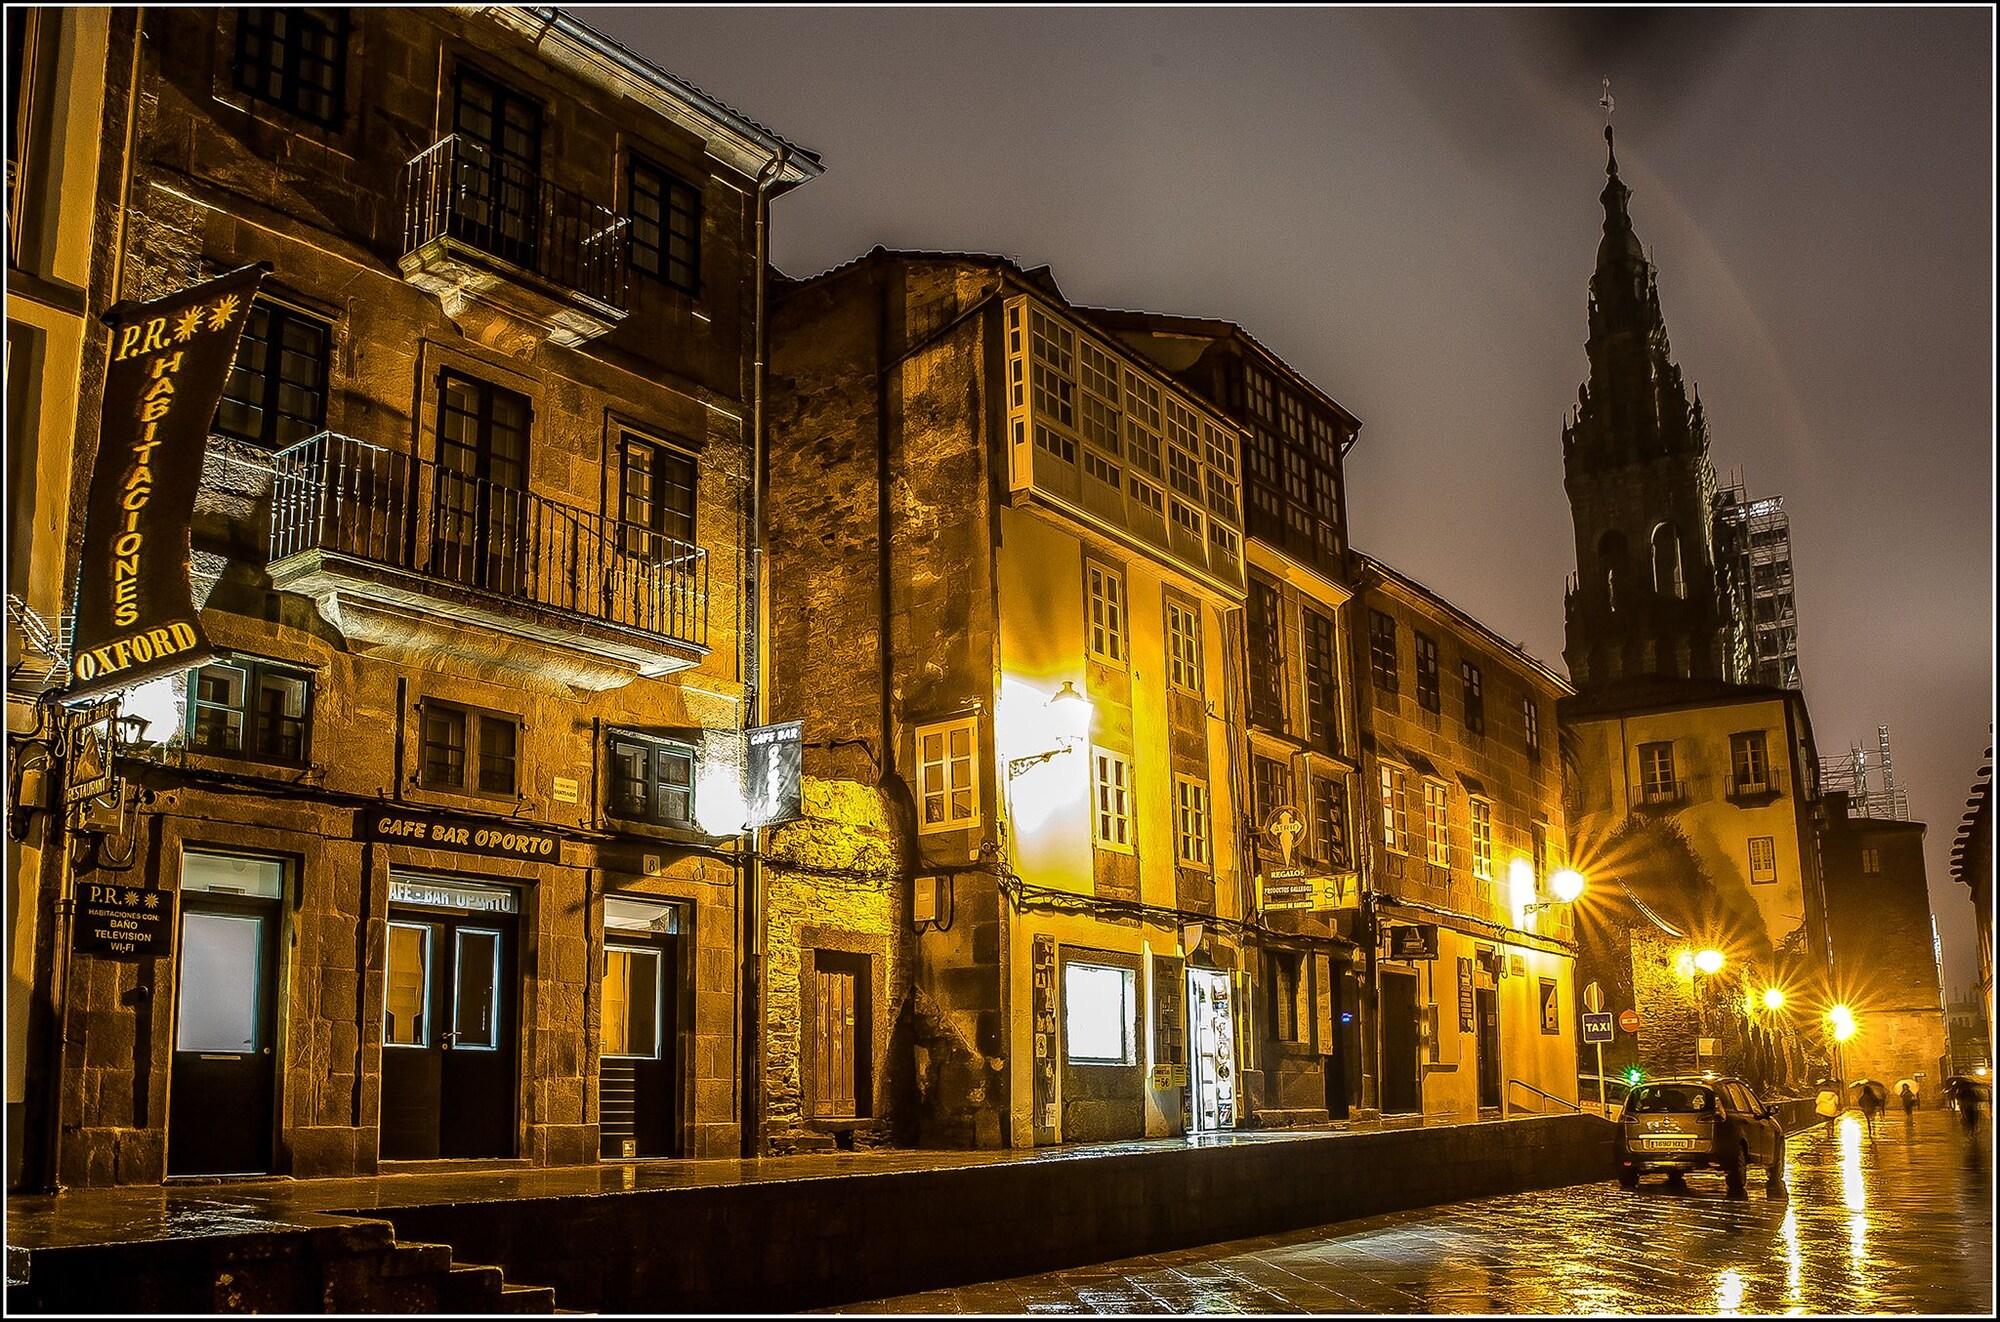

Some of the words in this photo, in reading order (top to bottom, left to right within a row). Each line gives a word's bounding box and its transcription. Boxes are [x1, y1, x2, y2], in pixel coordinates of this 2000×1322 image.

[115, 317, 171, 361] P.R.
[115, 351, 184, 627] HABITACIONES
[75, 622, 197, 681] OXFORD
[751, 731, 776, 746] CAFE
[777, 727, 799, 741] BAR
[378, 817, 427, 838] CAFE
[431, 825, 470, 846] BAR
[474, 829, 553, 855] OPORTO
[1270, 869, 1305, 879] REGALOS
[89, 886, 122, 905] P.R.
[88, 908, 141, 919] HABITACIONES
[110, 919, 138, 930] BAÑO
[95, 929, 152, 942] TELEVISION
[1586, 1022, 1610, 1032] TAXI
